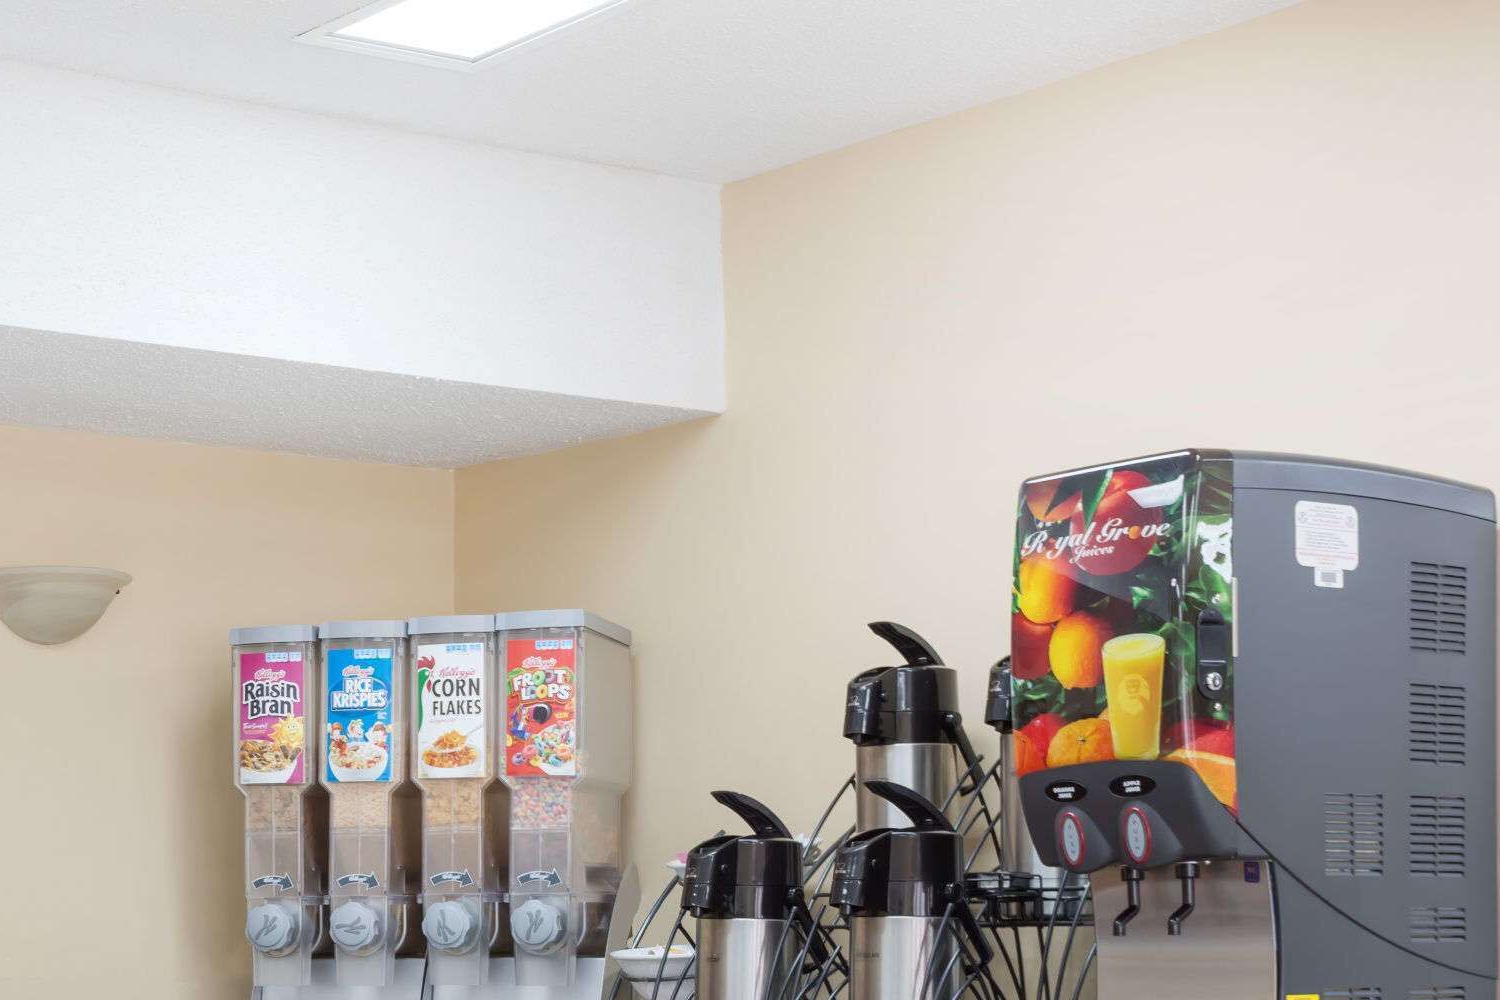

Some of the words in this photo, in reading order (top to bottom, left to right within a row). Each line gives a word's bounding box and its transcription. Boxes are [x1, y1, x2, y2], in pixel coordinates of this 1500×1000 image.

[1096, 517, 1171, 544] Grove
[1069, 545, 1116, 564] Juices
[346, 679, 373, 692] RICE
[432, 678, 480, 697] CORN
[514, 669, 567, 690] FROOT
[244, 682, 298, 700] Raisin
[332, 691, 387, 709] KRISPIES
[521, 684, 572, 700] LOOPS
[250, 699, 293, 716] Bran
[432, 700, 482, 716] FLAKES
